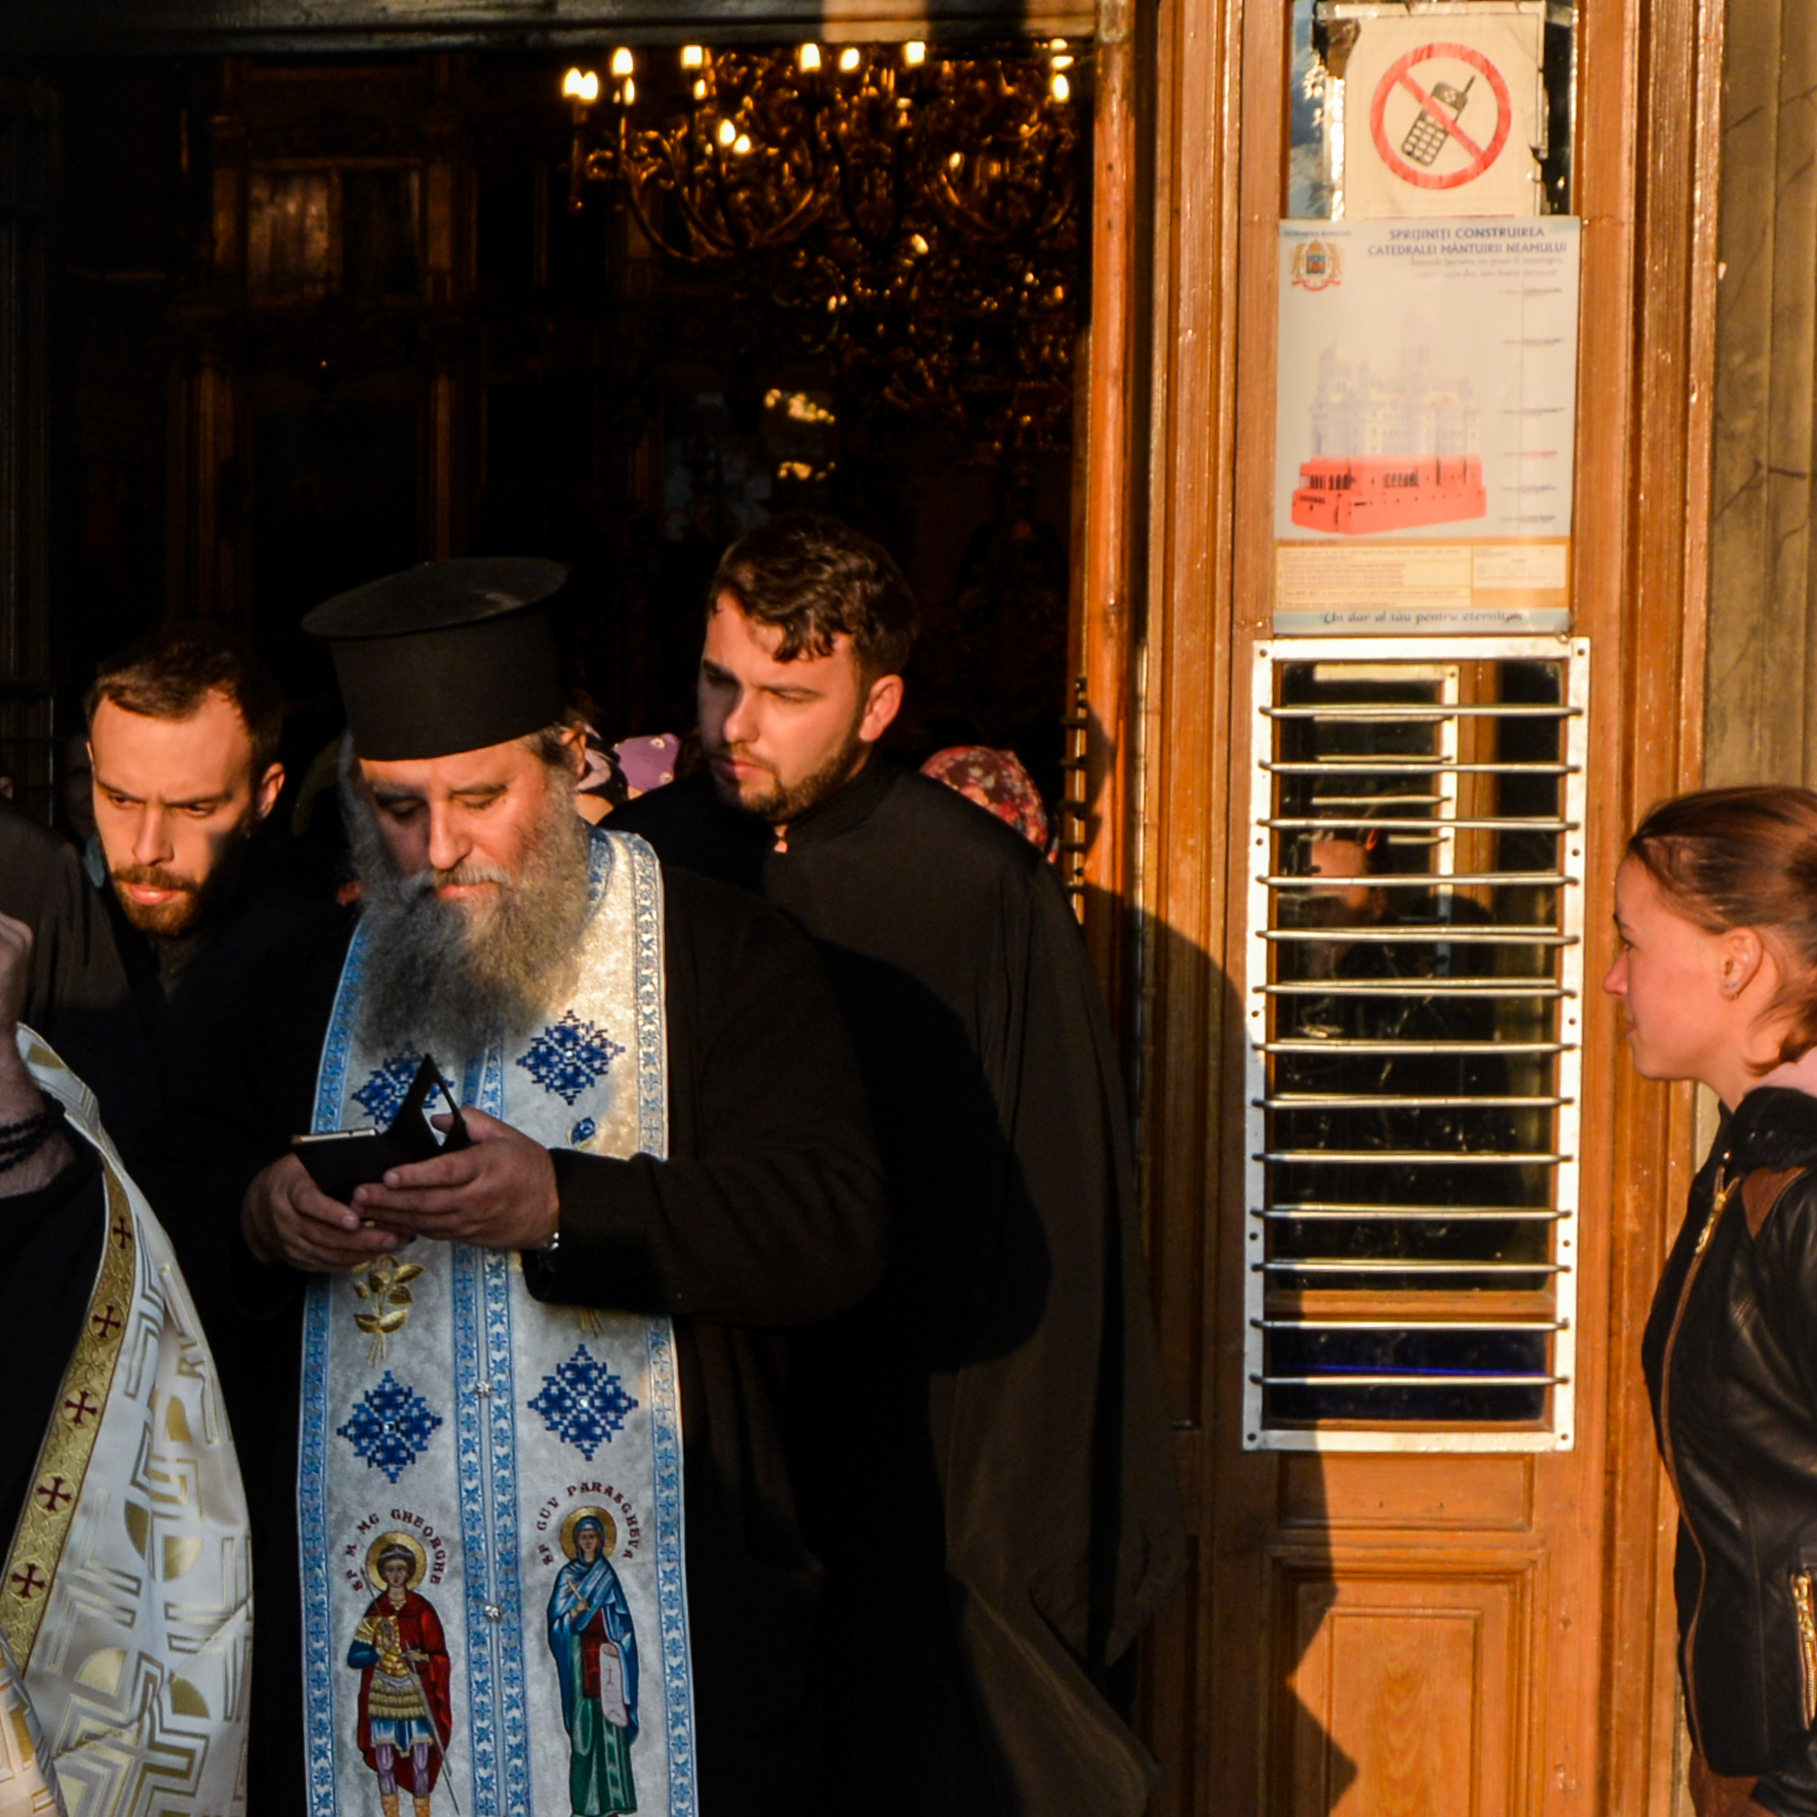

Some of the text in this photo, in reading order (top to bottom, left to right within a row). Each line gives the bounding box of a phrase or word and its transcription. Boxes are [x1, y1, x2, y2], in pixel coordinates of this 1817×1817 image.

[1456, 226, 1545, 239] CONSTRUIREA
[1367, 240, 1567, 256] CATEDRALEI MÂNTUIRII NEAMULUI
[1349, 611, 1372, 623] dar
[1376, 610, 1387, 623] al
[1416, 612, 1458, 625] pentru
[345, 1544, 357, 1557] M
[390, 1508, 446, 1586] GHEORGHE
